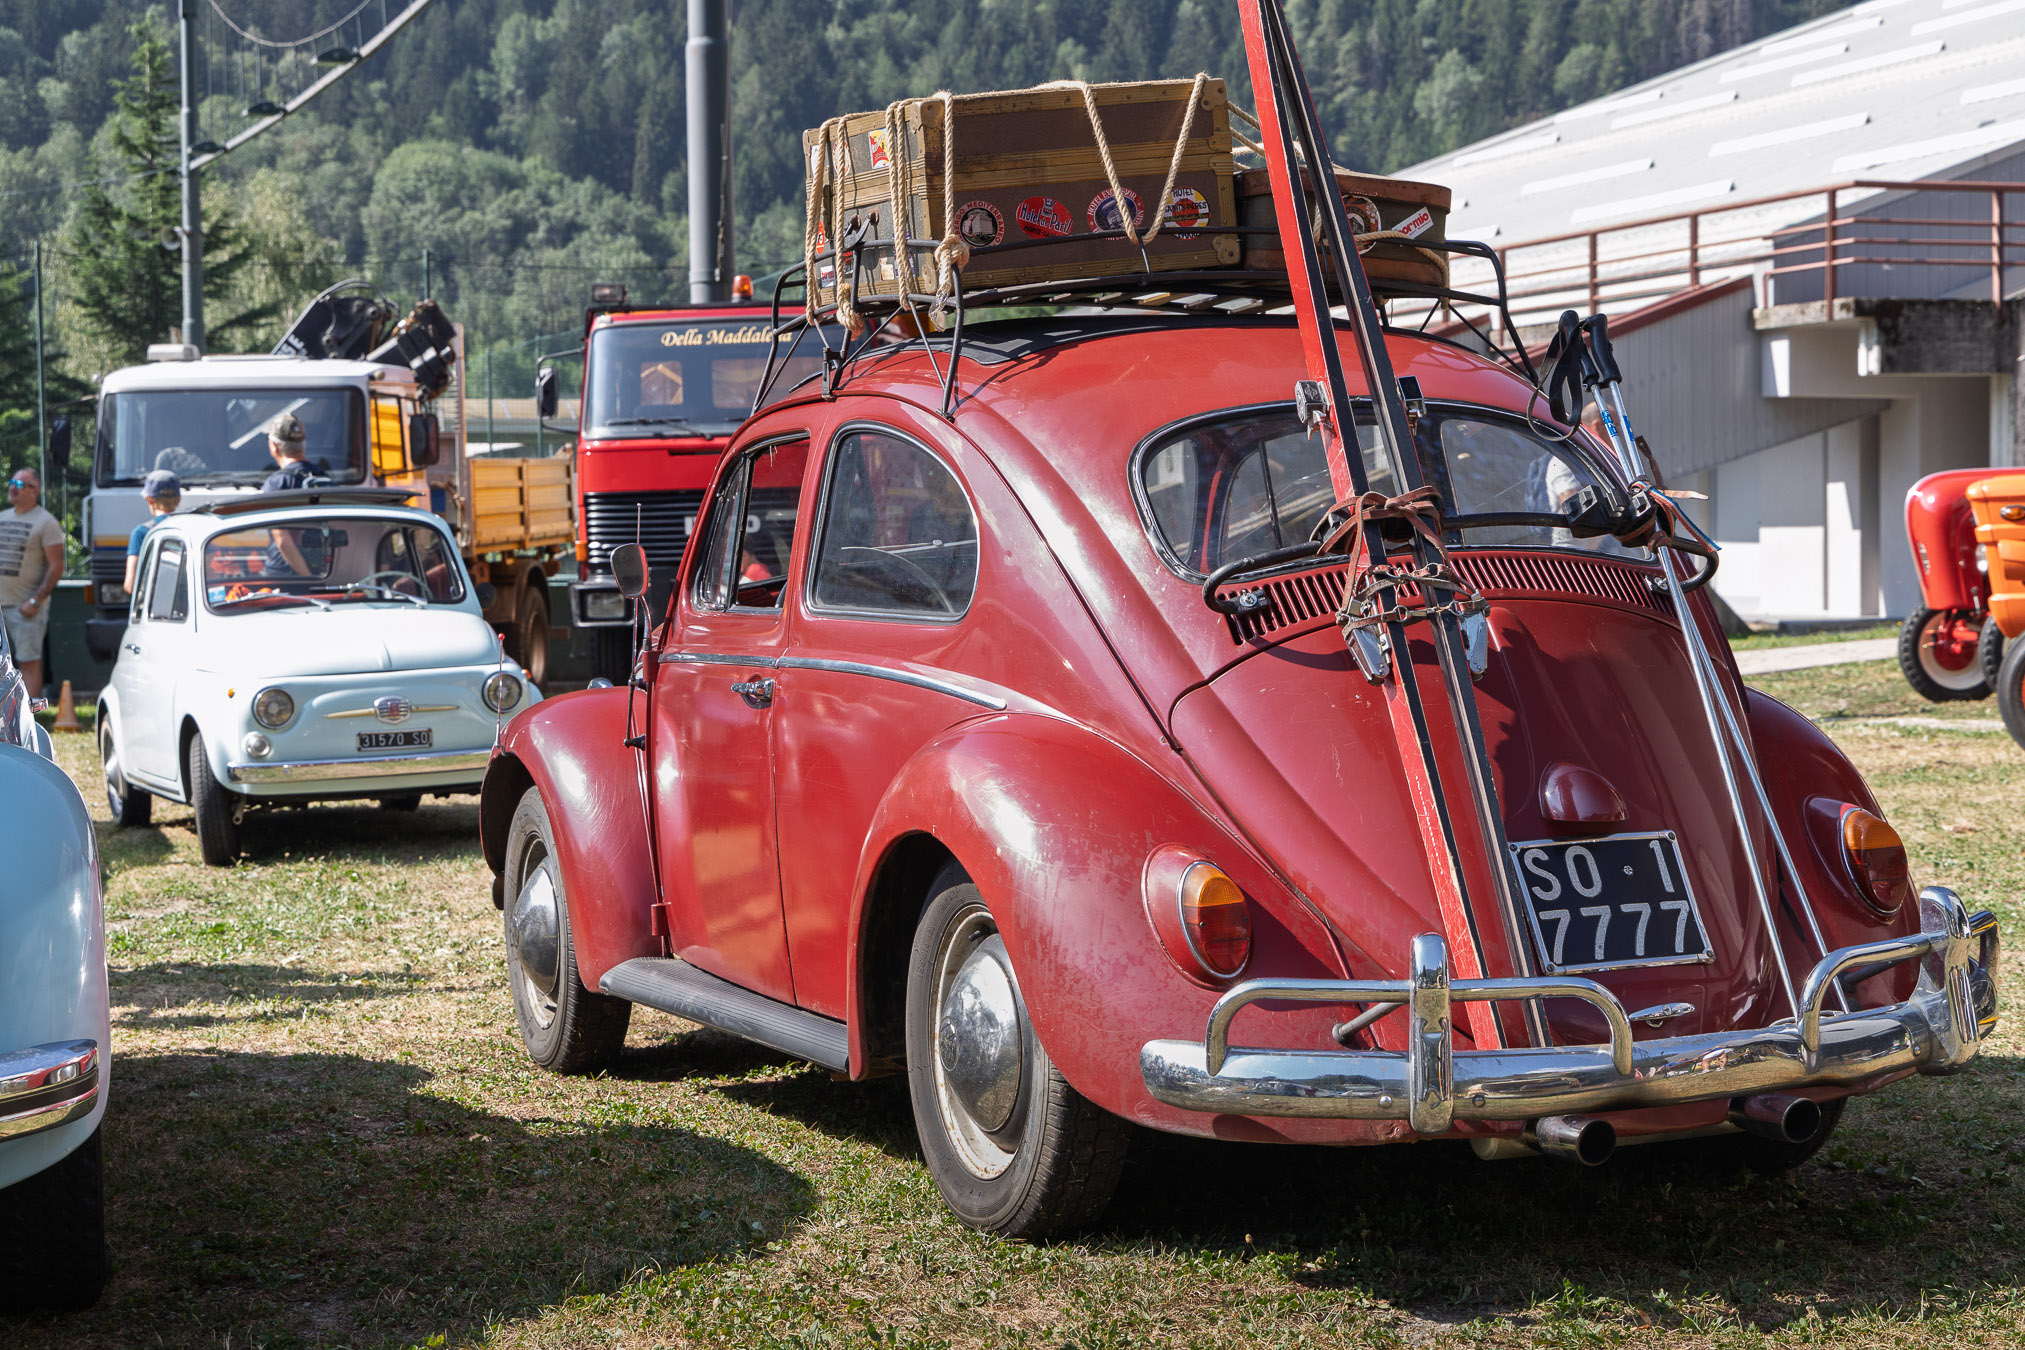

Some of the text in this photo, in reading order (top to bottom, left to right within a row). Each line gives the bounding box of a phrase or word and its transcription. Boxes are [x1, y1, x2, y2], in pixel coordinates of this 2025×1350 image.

[1173, 188, 1193, 197] HOTEL
[1019, 203, 1043, 225] Hotel
[1087, 195, 1104, 216] HOTEL
[966, 201, 1005, 244] MEDITERRANEO
[1396, 212, 1430, 235] ormio
[661, 328, 702, 347] Della
[362, 731, 428, 748] 31570 SO
[1523, 839, 1675, 901] SO 1
[1538, 900, 1690, 965] 7777
